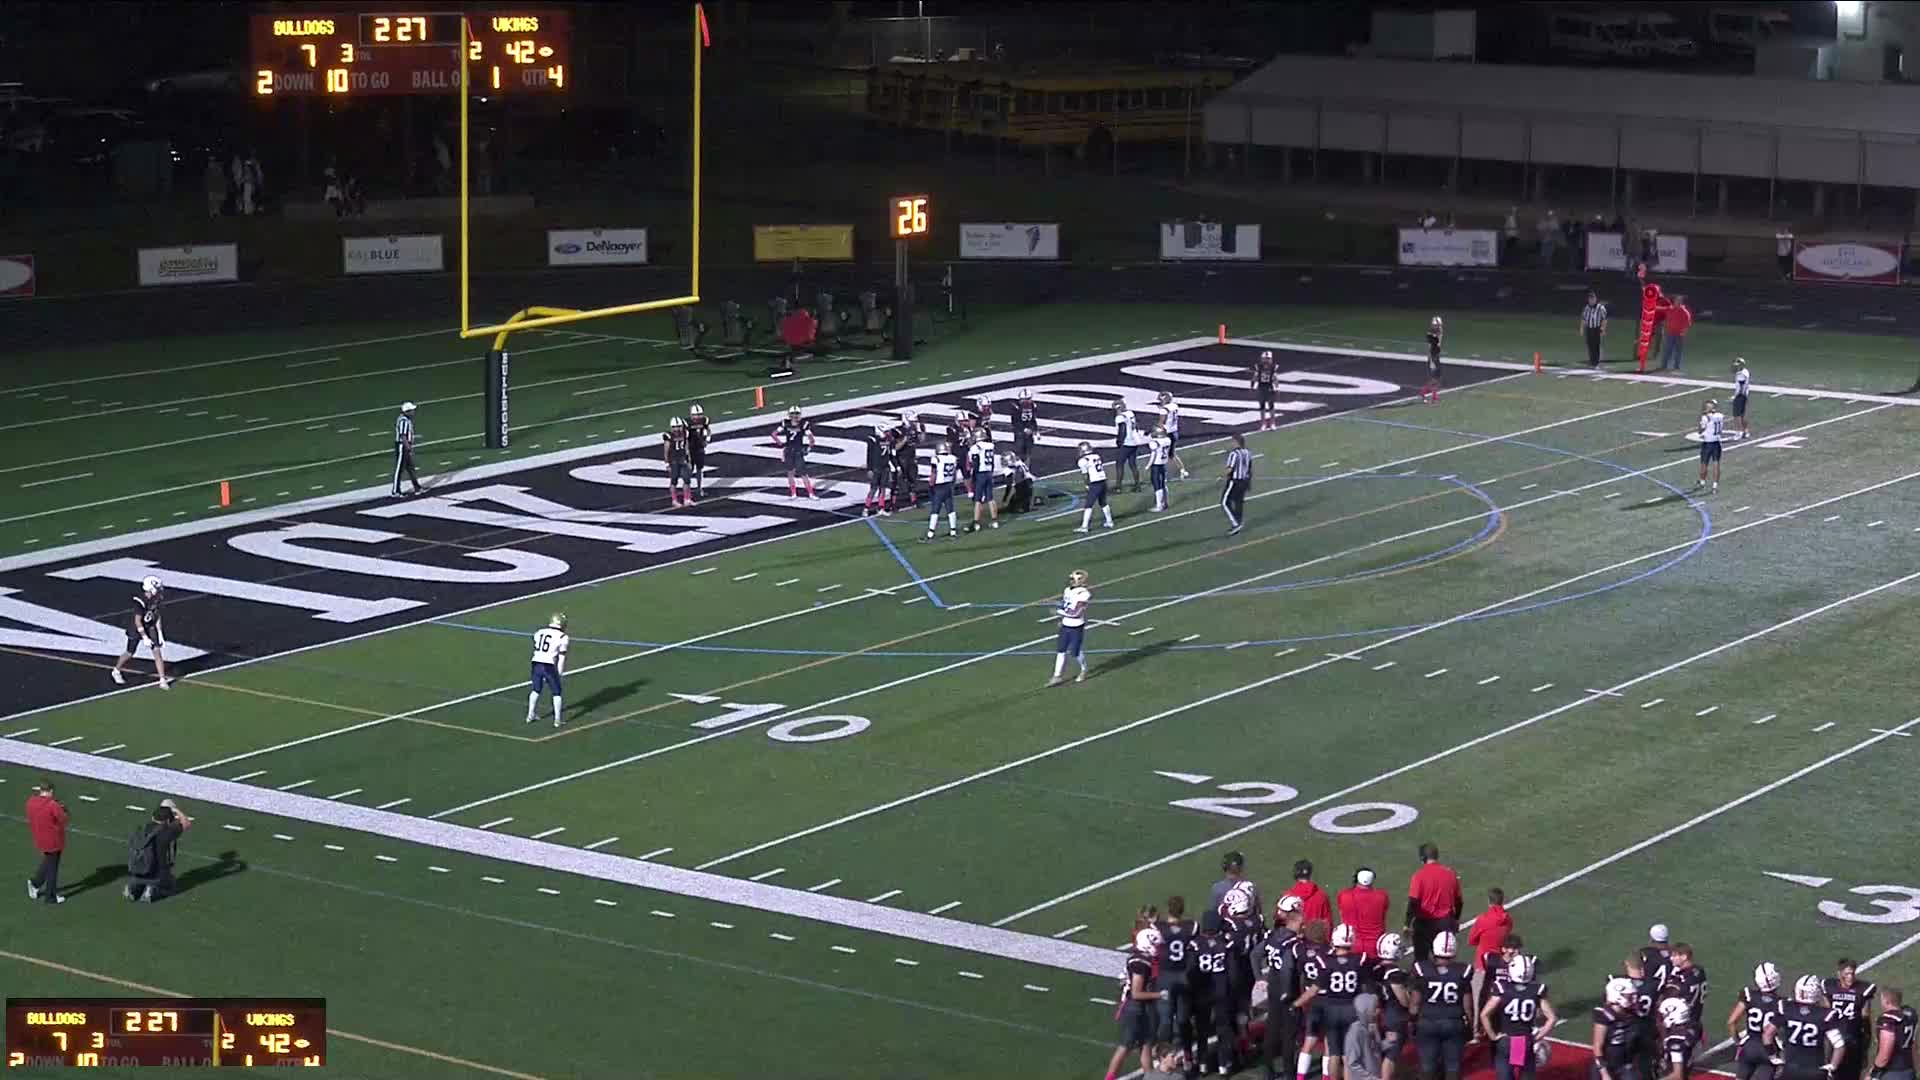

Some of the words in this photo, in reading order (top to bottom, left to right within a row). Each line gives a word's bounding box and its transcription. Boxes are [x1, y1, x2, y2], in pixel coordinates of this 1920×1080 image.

[273, 19, 335, 36] BULLDOGS
[492, 16, 540, 33] VIKINGS
[301, 44, 316, 67] 7
[341, 43, 354, 63] 3
[469, 41, 483, 60] 2
[506, 41, 535, 64] 42
[257, 70, 273, 94] 2
[327, 69, 349, 93] 10
[370, 71, 390, 89] GO
[412, 71, 448, 89] BALL
[493, 66, 500, 89] 1
[547, 65, 563, 88] 4
[897, 199, 926, 235] 26
[501, 352, 509, 447] BULLDOGS
[690, 702, 872, 742] 10
[1168, 781, 1419, 834] 20
[1168, 941, 1184, 962] 9
[1198, 953, 1225, 974] 82
[1329, 971, 1358, 993] 88
[1427, 982, 1459, 1004] 76
[1503, 998, 1536, 1023] 40
[1787, 1020, 1819, 1047] 72
